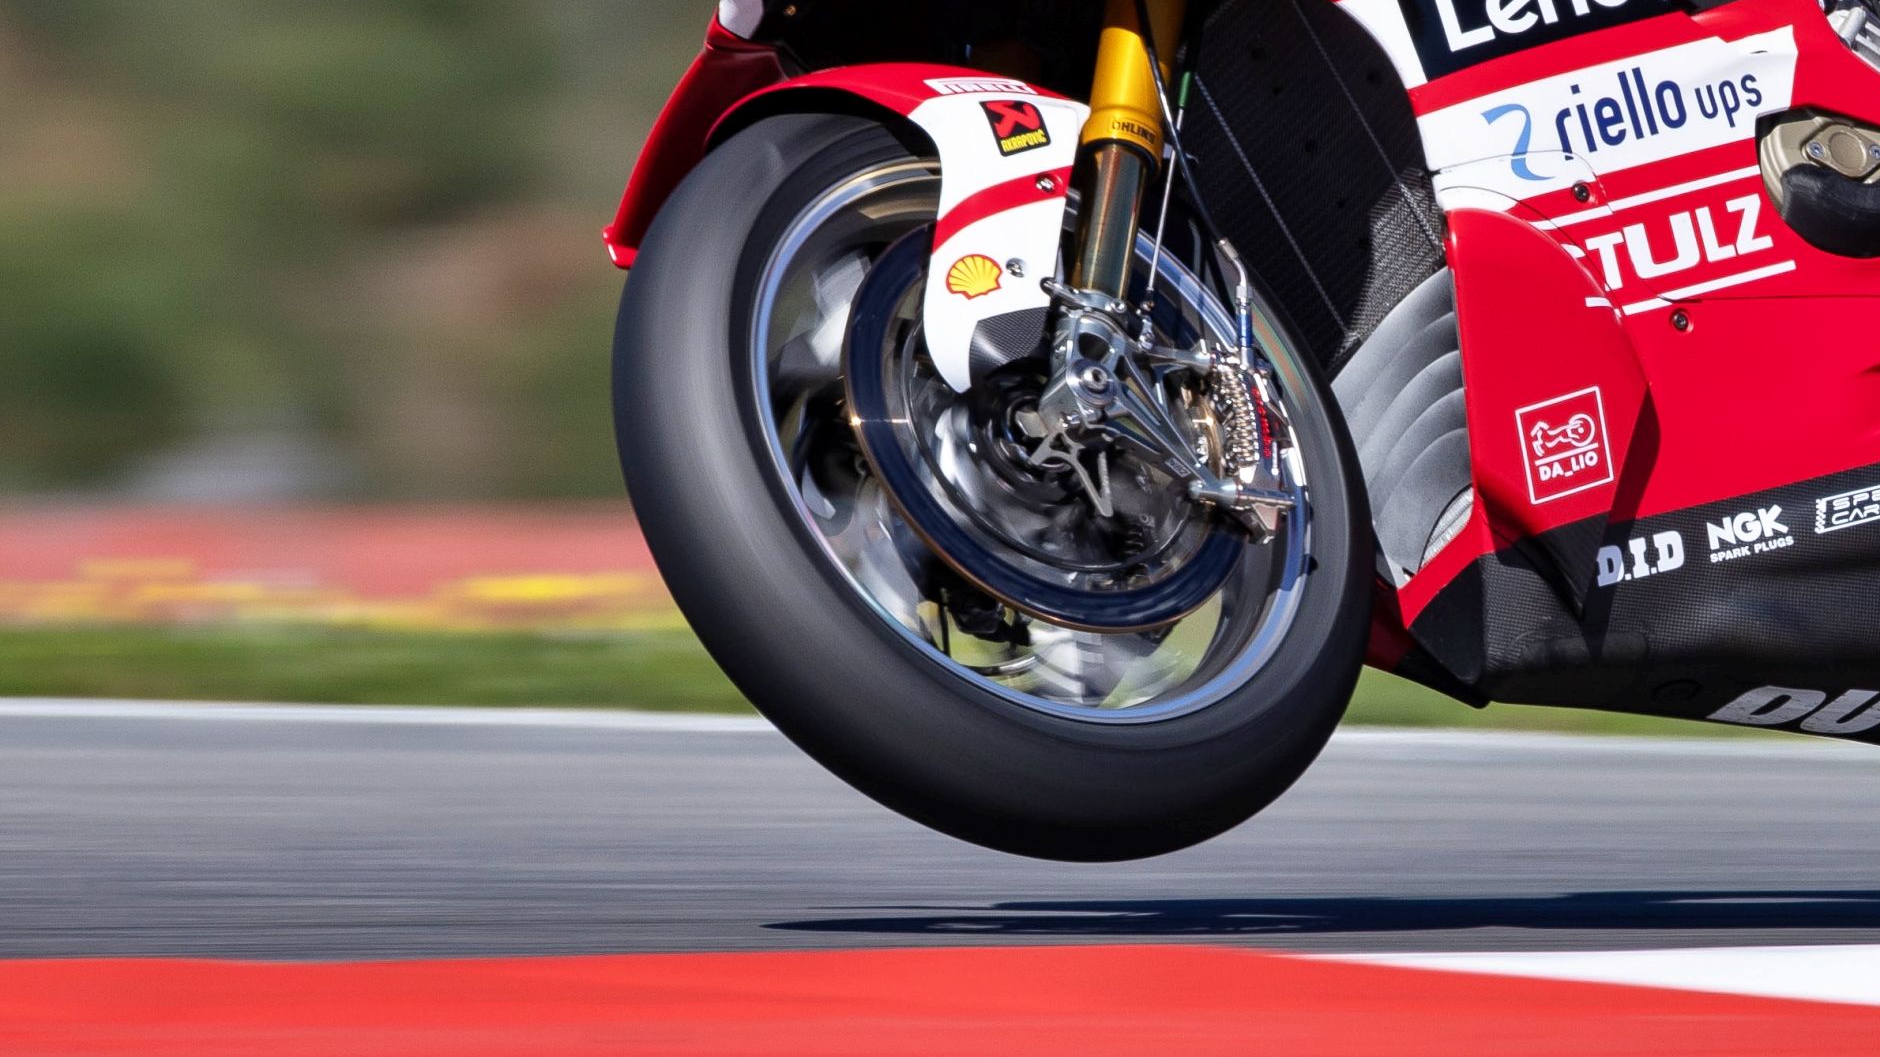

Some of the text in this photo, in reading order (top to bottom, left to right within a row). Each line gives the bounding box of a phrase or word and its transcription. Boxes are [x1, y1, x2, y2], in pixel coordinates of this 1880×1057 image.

[1556, 66, 1763, 161] riello ups
[1562, 193, 1774, 292] TULZ
[1706, 504, 1790, 551] NGK
[1709, 535, 1795, 564] SPARK PLUGS
[1596, 530, 1686, 588] D.I.D
